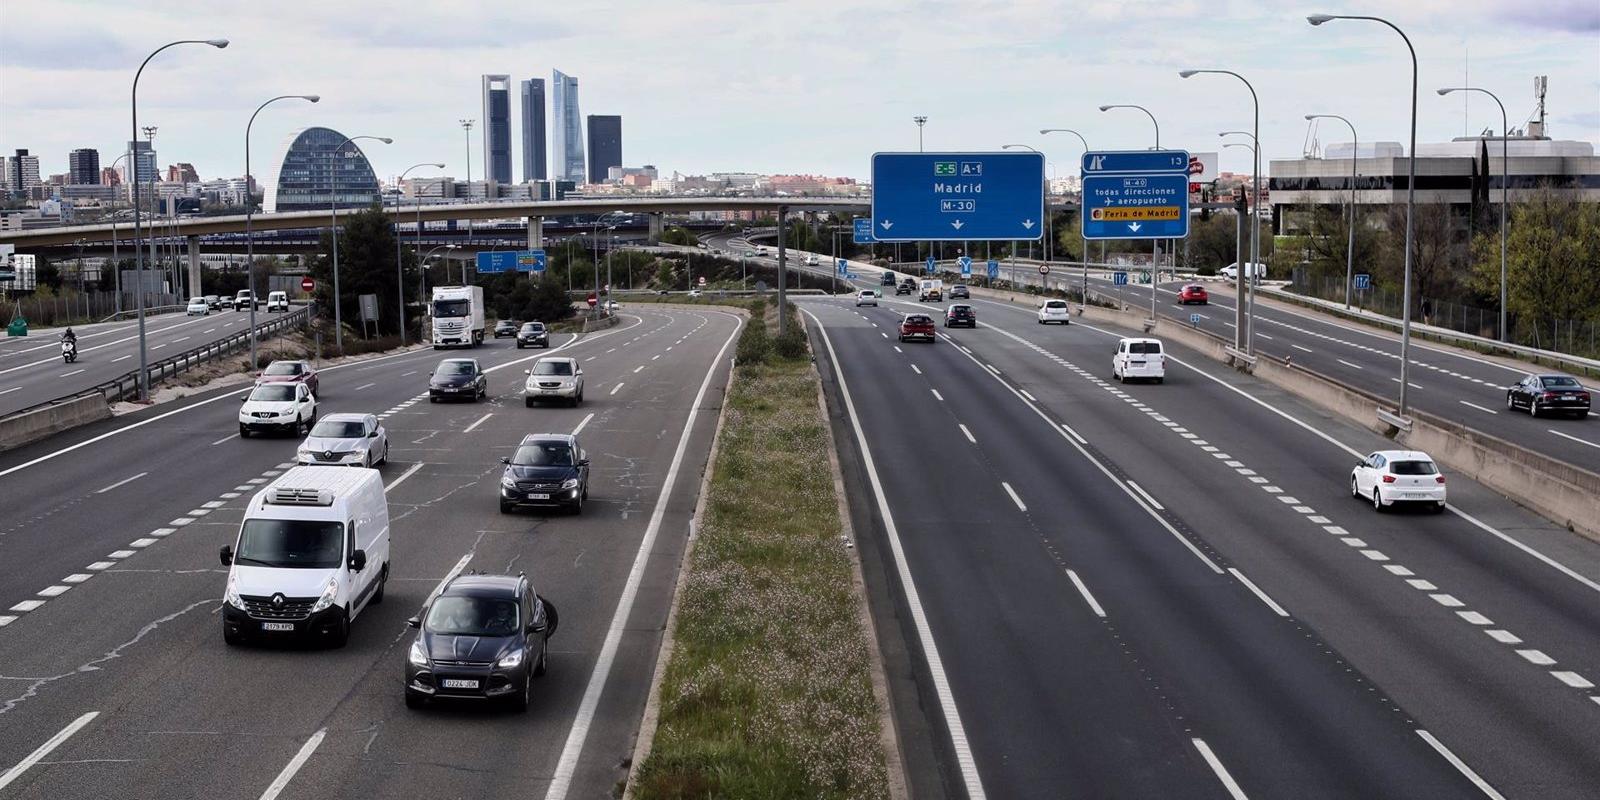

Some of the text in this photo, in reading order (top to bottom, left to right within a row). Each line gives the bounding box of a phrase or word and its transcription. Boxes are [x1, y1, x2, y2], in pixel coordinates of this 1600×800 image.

[1171, 157, 1182, 165] 13
[935, 164, 981, 174] E-5 A-1
[934, 183, 982, 193] Madrid
[943, 202, 973, 210] M-30
[1118, 197, 1167, 206] aeropuerto
[1104, 210, 1128, 218] Feria
[1147, 209, 1179, 217] Madrid
